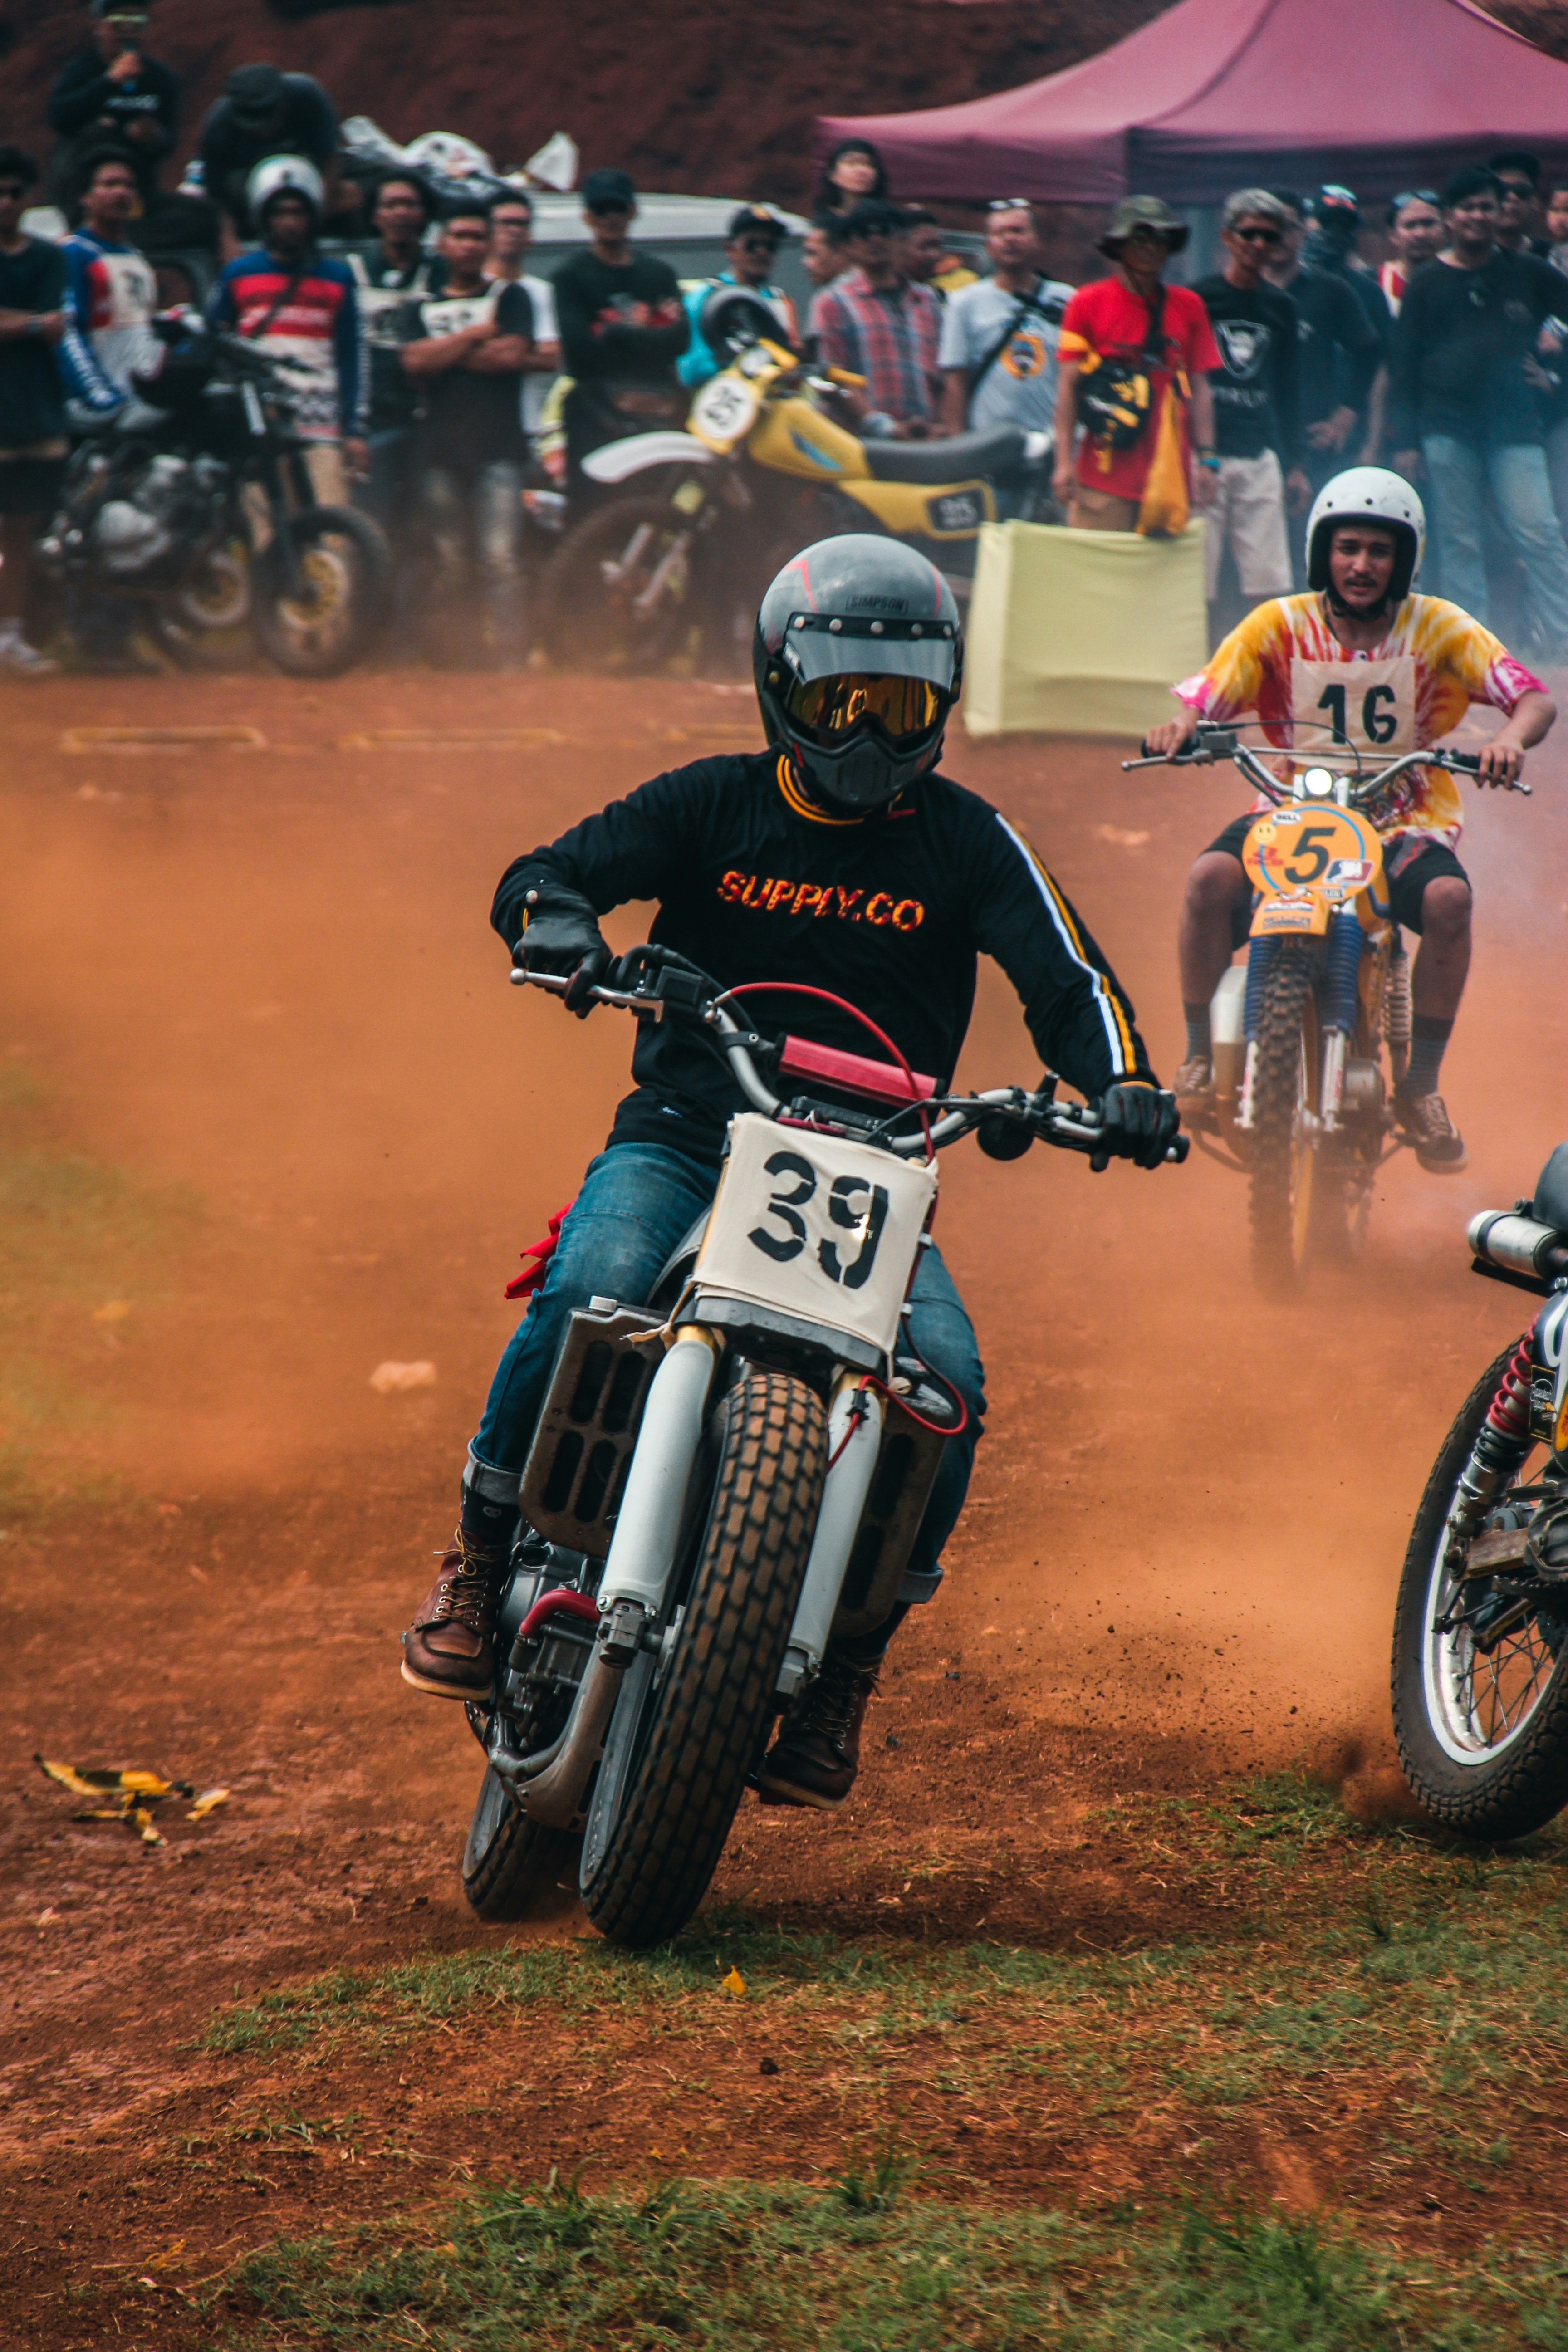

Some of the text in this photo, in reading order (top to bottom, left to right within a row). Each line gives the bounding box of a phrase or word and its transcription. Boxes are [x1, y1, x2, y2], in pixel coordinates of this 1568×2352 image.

[850, 596, 903, 610] SIMPSON
[1318, 684, 1397, 744] 16
[1284, 827, 1336, 884] 5
[717, 870, 925, 931] SUPPLY.CO
[747, 1150, 888, 1289] 39
